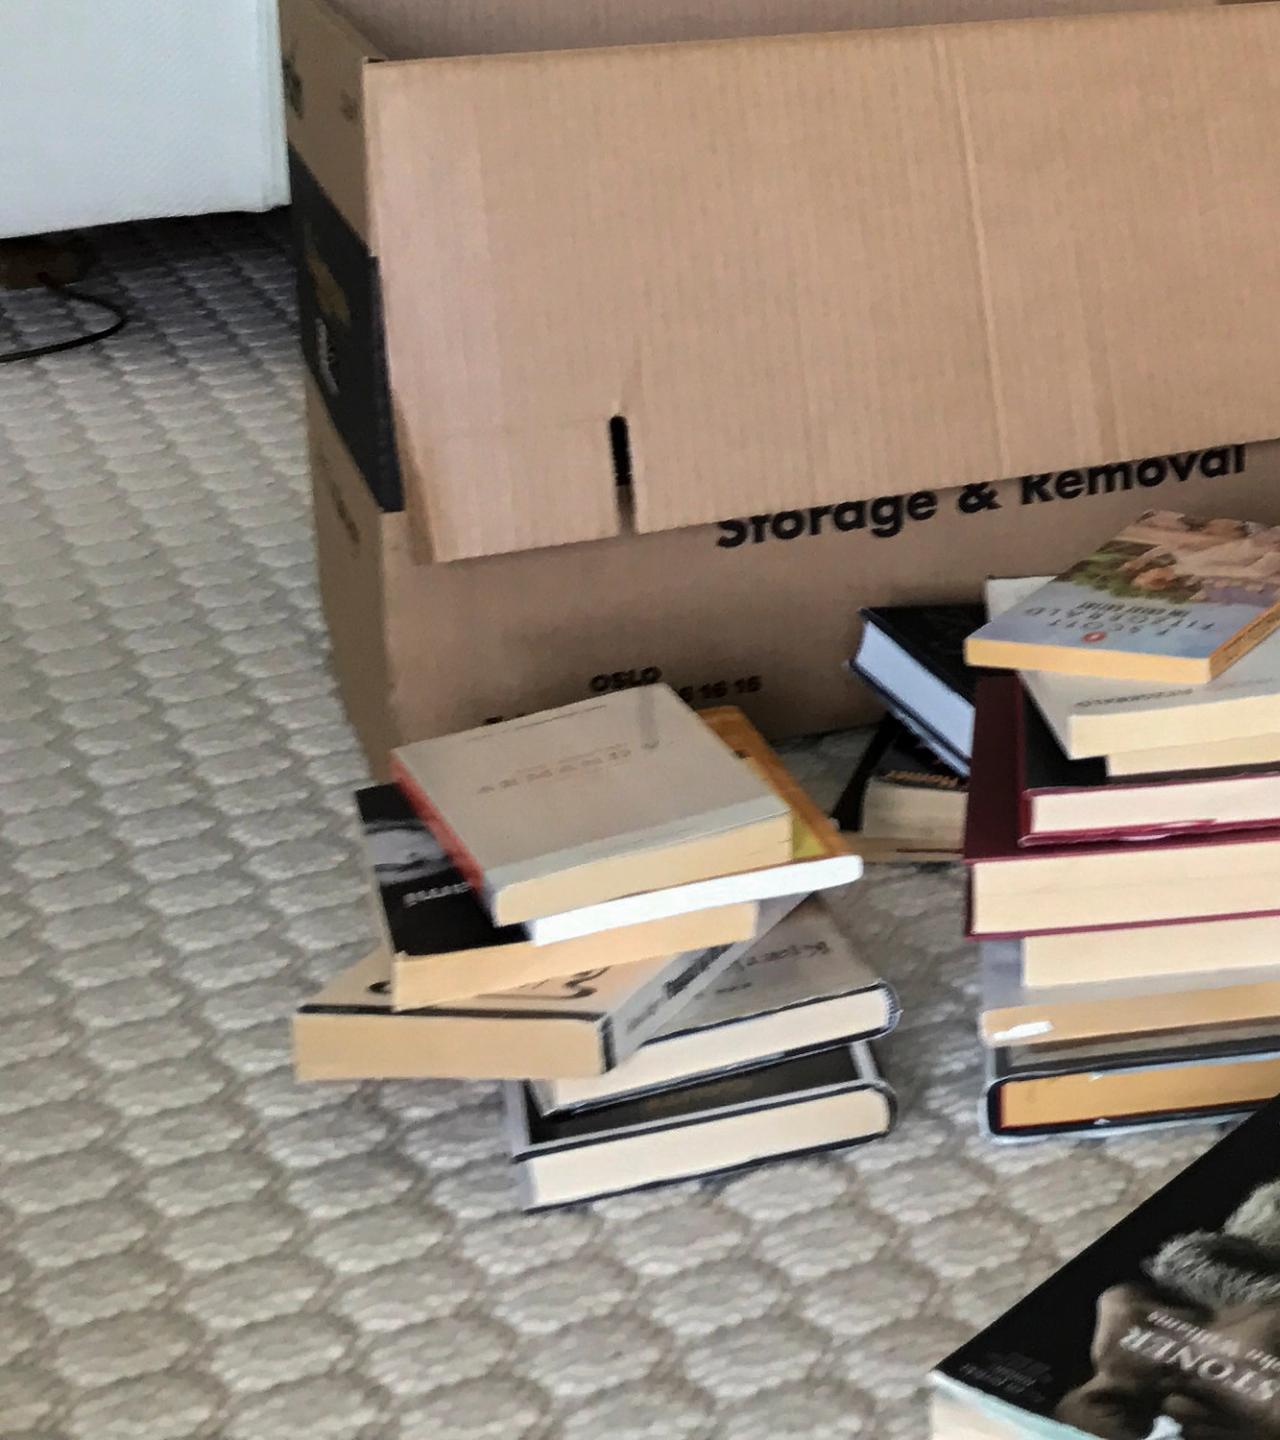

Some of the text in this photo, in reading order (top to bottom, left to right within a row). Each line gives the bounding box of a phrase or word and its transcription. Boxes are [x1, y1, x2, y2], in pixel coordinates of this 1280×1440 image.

[716, 444, 1247, 548] Storage & Removal
[589, 666, 662, 692] OSLO
[1147, 1311, 1240, 1357] Williams
